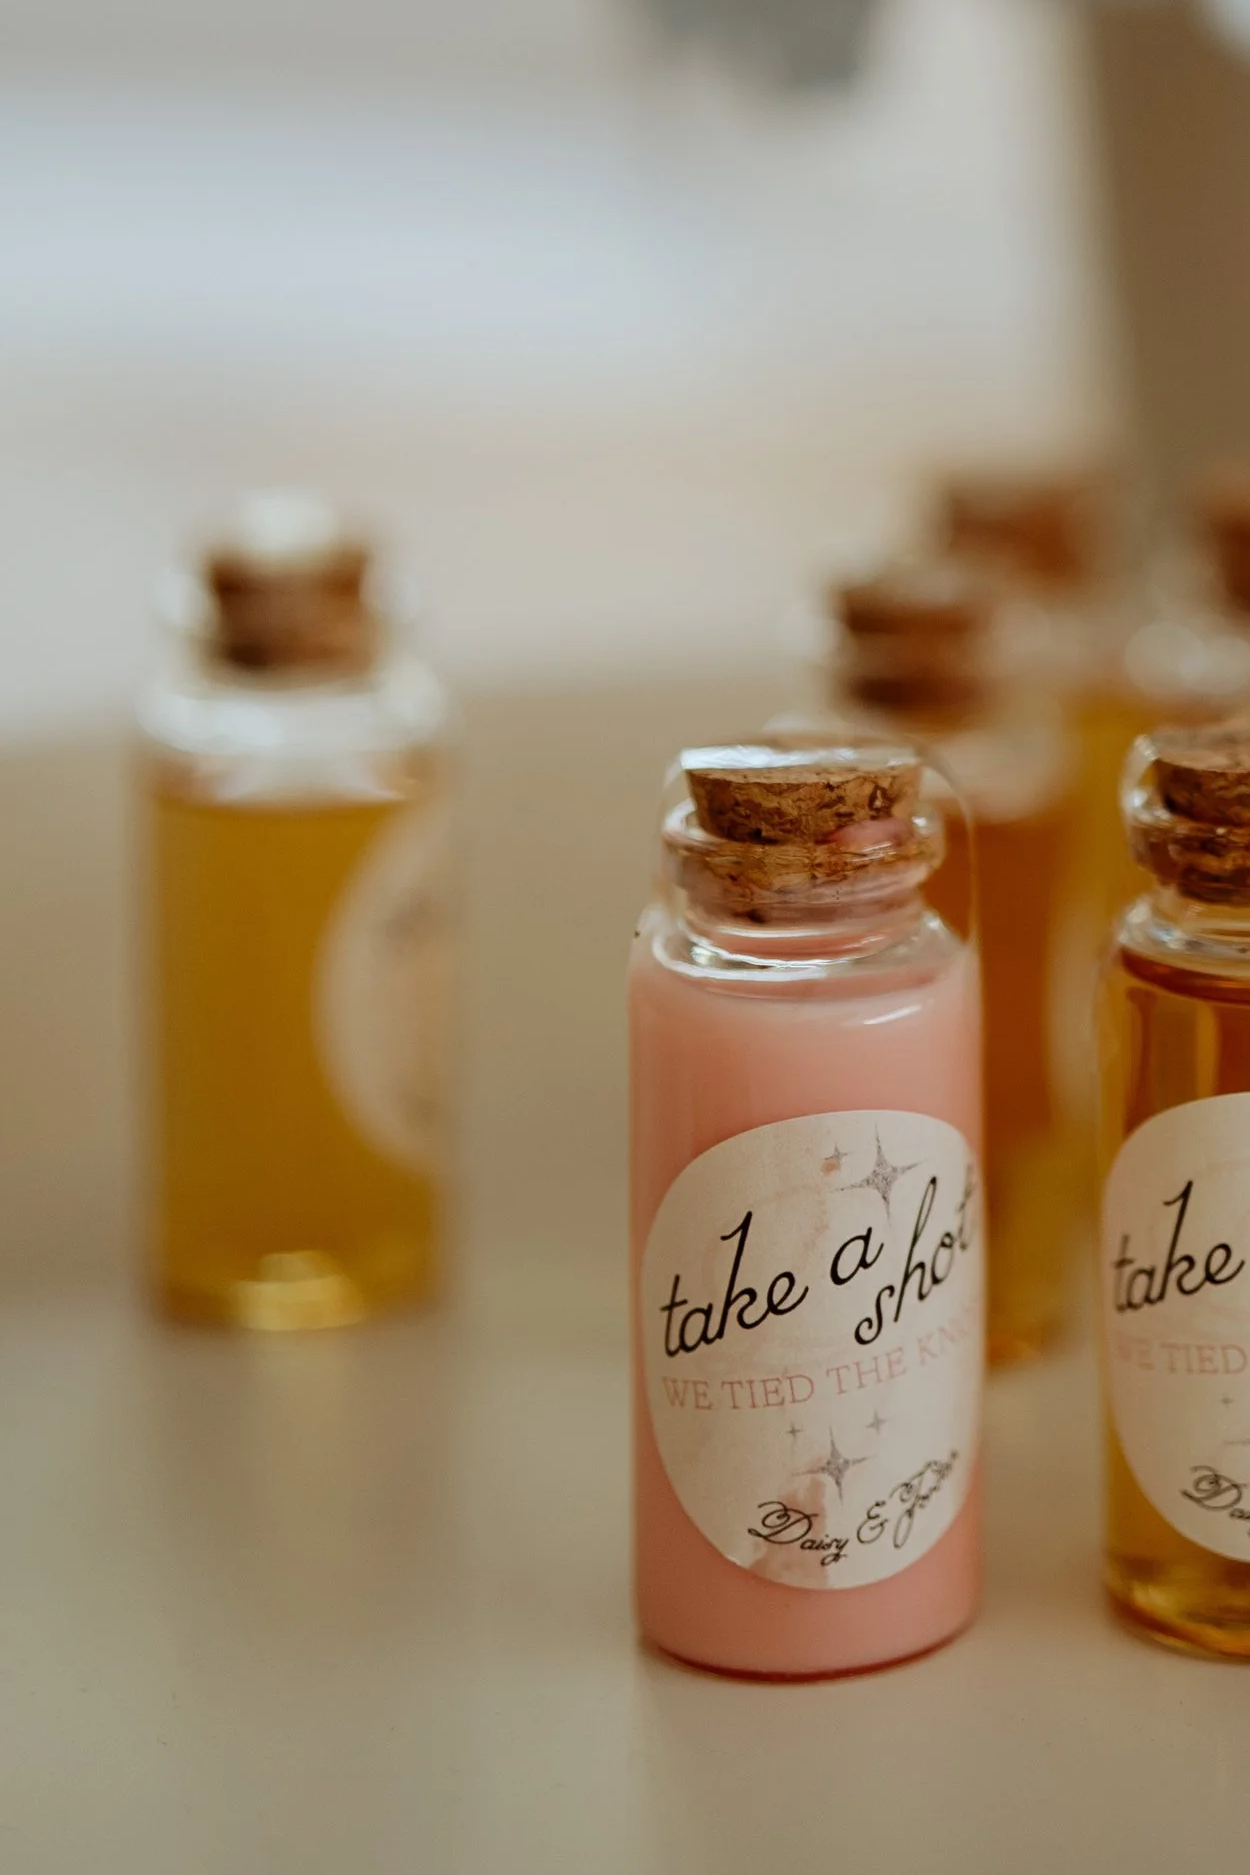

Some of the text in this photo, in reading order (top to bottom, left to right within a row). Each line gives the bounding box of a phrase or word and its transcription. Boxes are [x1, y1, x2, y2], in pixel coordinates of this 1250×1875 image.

[659, 1211, 884, 1357] take a
[854, 1162, 977, 1345] shot
[1111, 1180, 1245, 1314] take
[661, 1375, 712, 1412] WE
[720, 1374, 815, 1411] TIED
[826, 1346, 908, 1398] THE
[1160, 1342, 1248, 1376] TIED
[747, 1501, 850, 1566] Daisy
[857, 1501, 889, 1544] &
